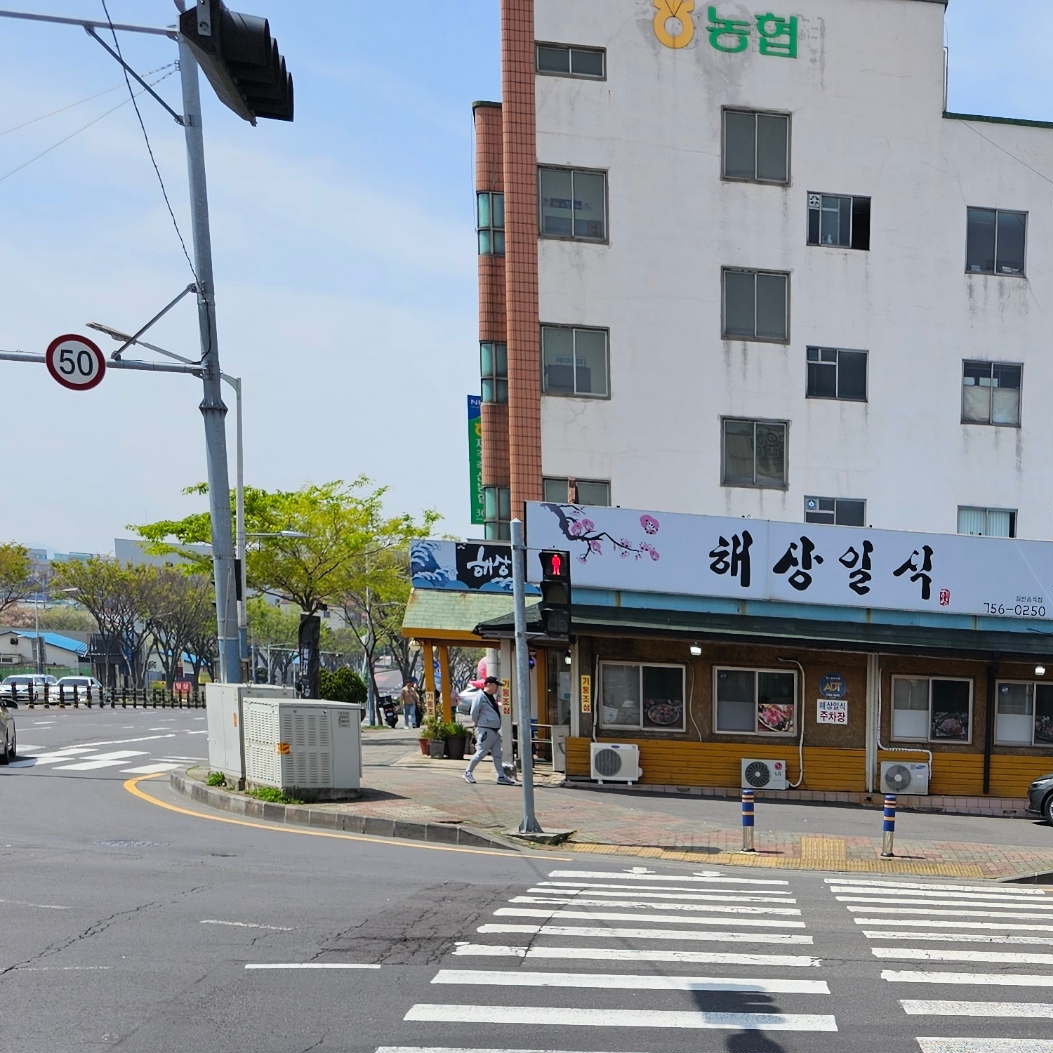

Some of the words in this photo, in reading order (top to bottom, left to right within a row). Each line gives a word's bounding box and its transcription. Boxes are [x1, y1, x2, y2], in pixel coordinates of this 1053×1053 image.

[705, 6, 797, 59] 농협
[59, 349, 93, 376] 50
[466, 545, 511, 578] 해상
[709, 530, 934, 600] 해상일식
[983, 602, 1046, 617] 756-0250
[823, 681, 842, 692] ADT
[820, 711, 846, 723] 주차장
